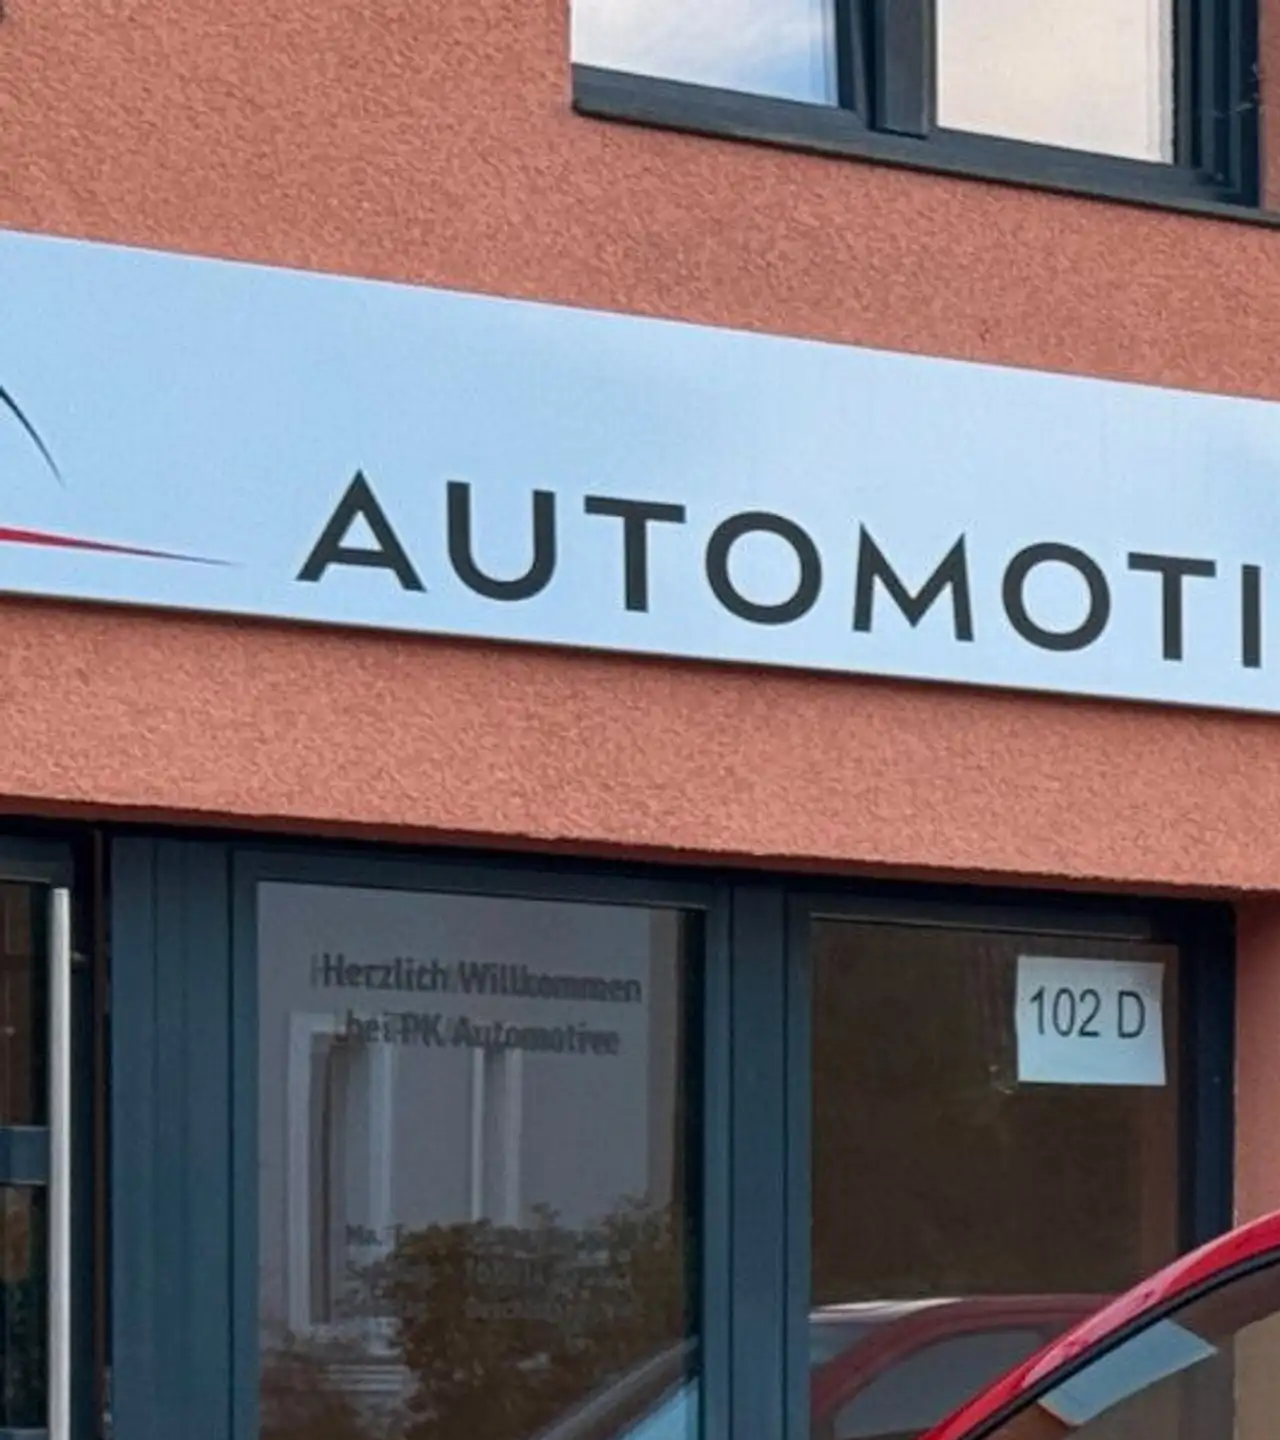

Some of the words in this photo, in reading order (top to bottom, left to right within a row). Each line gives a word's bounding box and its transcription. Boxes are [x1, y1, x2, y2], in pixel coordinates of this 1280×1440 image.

[320, 952, 449, 993] Herzlich
[455, 958, 643, 1002] Willkommen
[450, 1015, 621, 1056] Automotive
[1030, 986, 1101, 1037] 102
[1117, 990, 1146, 1039] D
